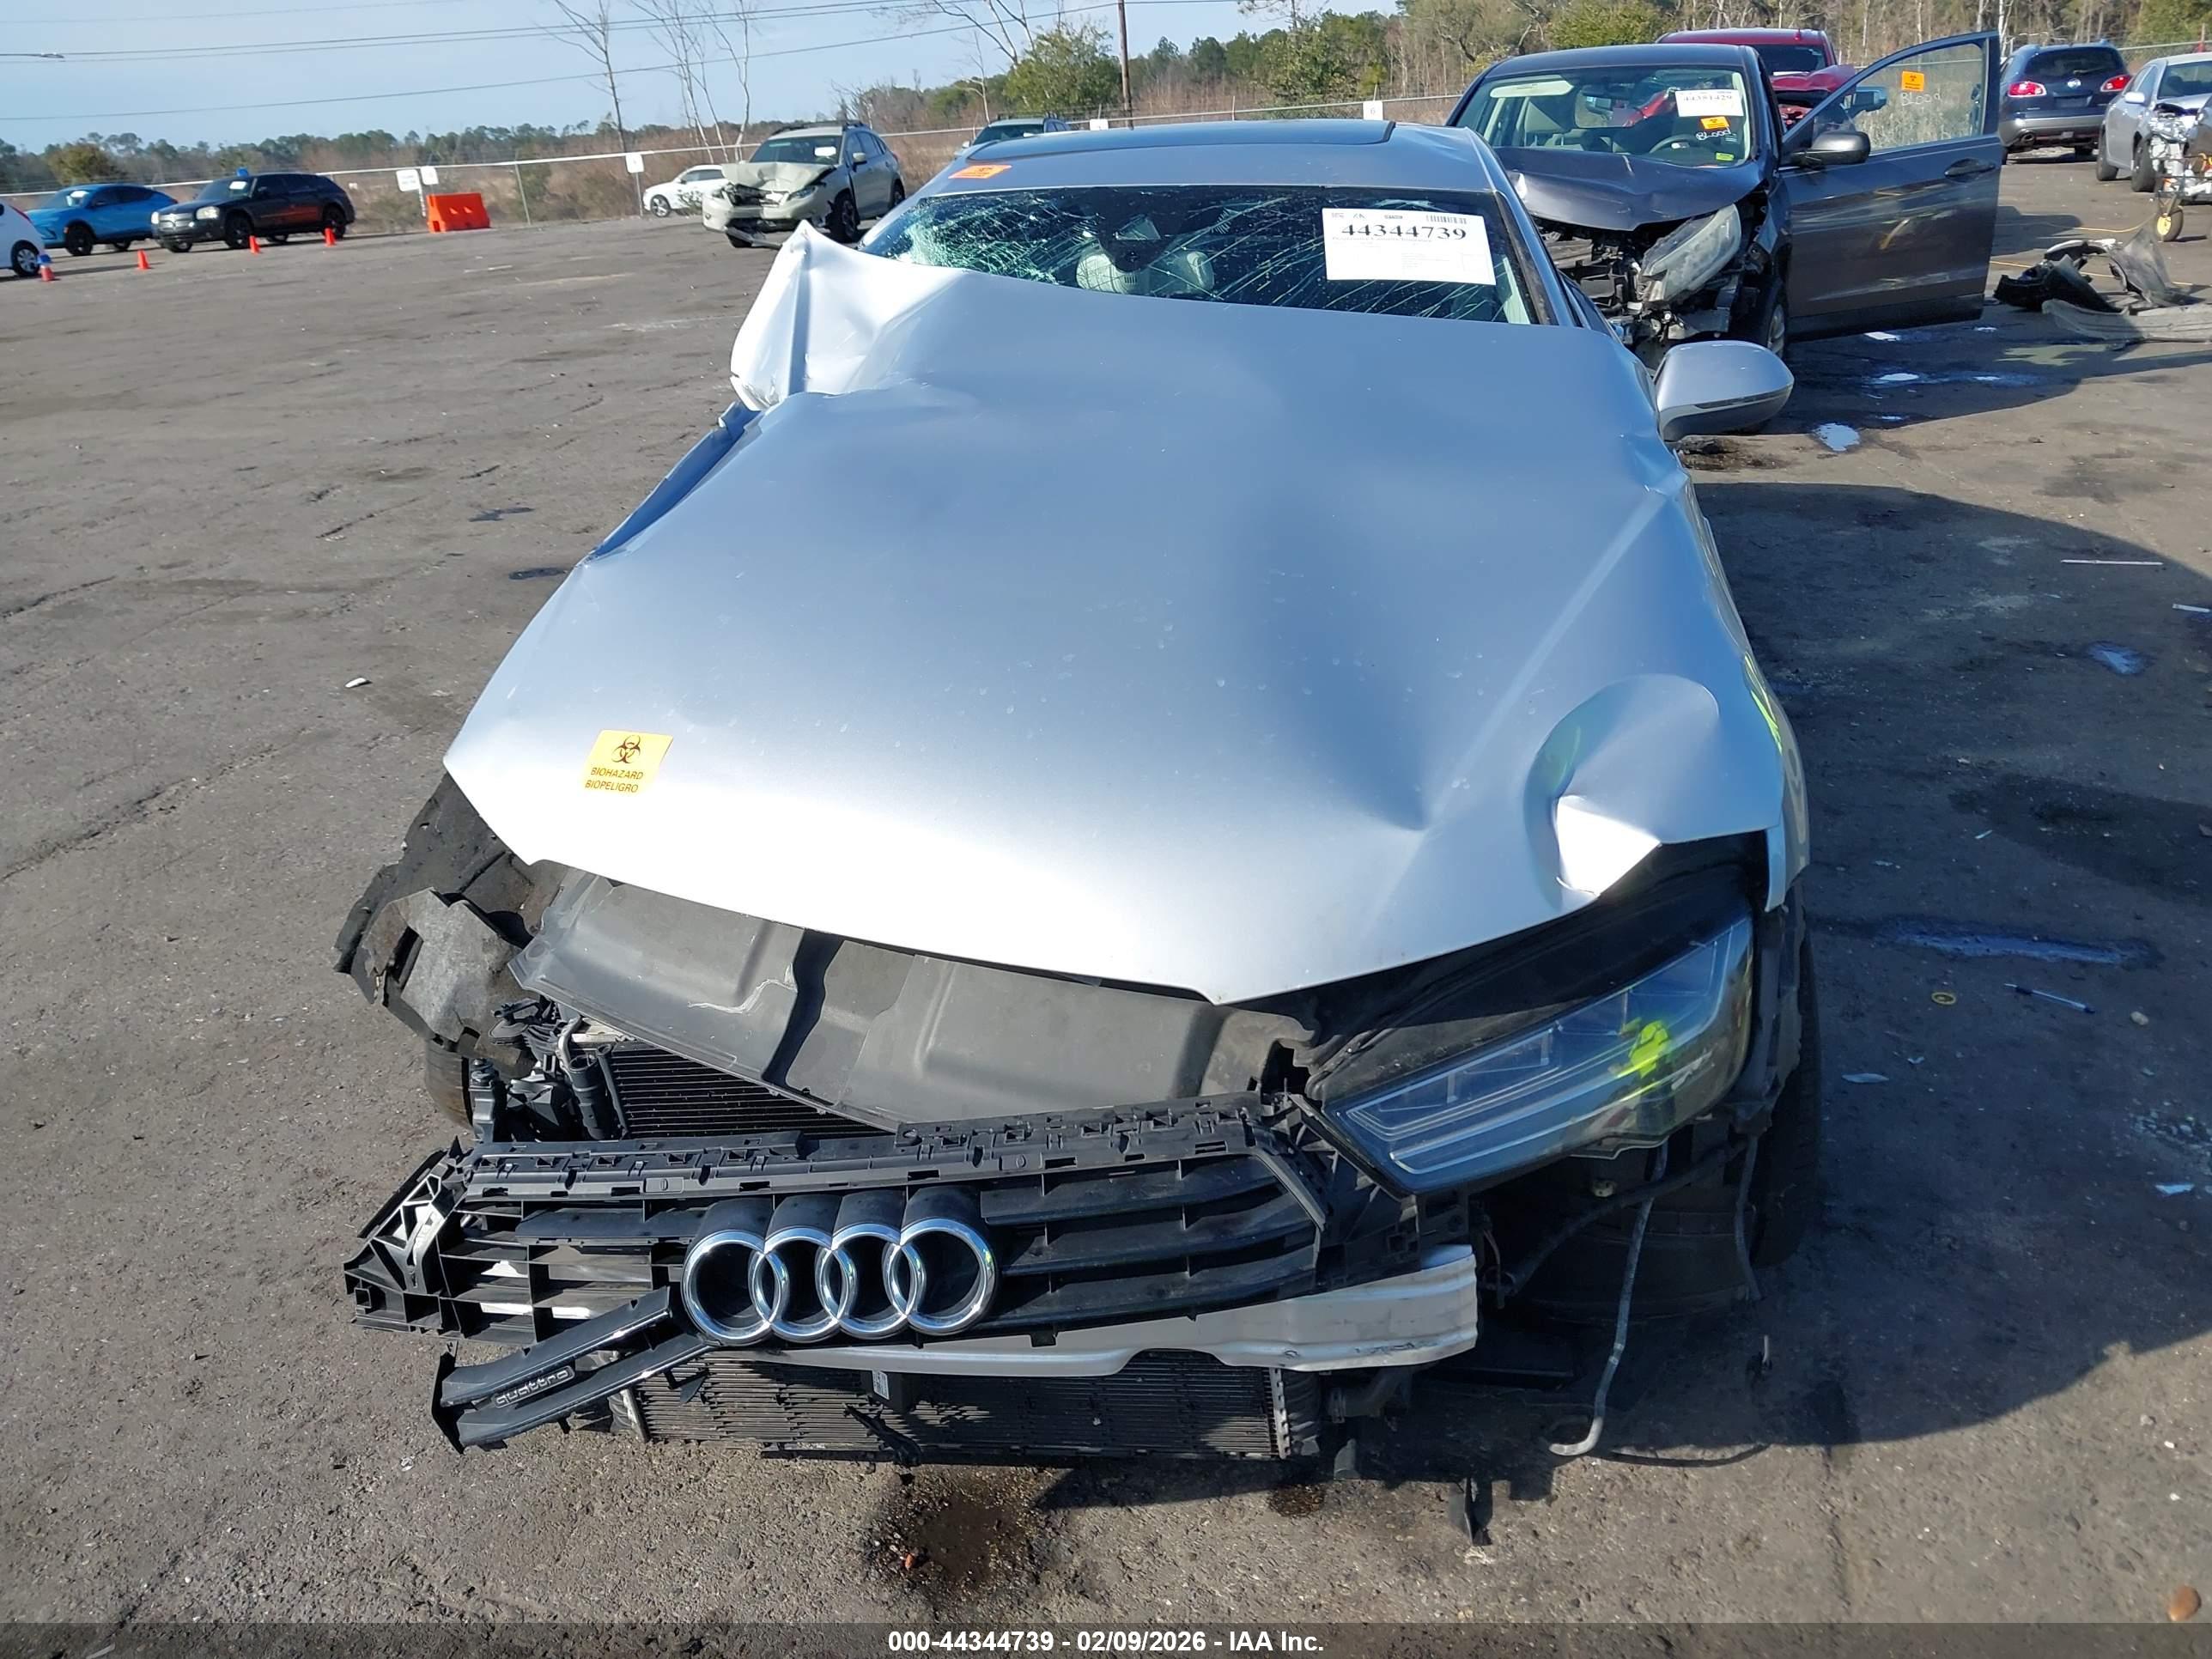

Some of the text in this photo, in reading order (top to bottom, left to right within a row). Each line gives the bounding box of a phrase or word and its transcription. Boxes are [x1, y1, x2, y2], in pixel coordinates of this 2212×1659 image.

[1341, 224, 1467, 240] 44344739
[590, 767, 644, 780] BIOHAZARD
[585, 779, 639, 793] BIOPELIGRO
[495, 1370, 568, 1404] quattro
